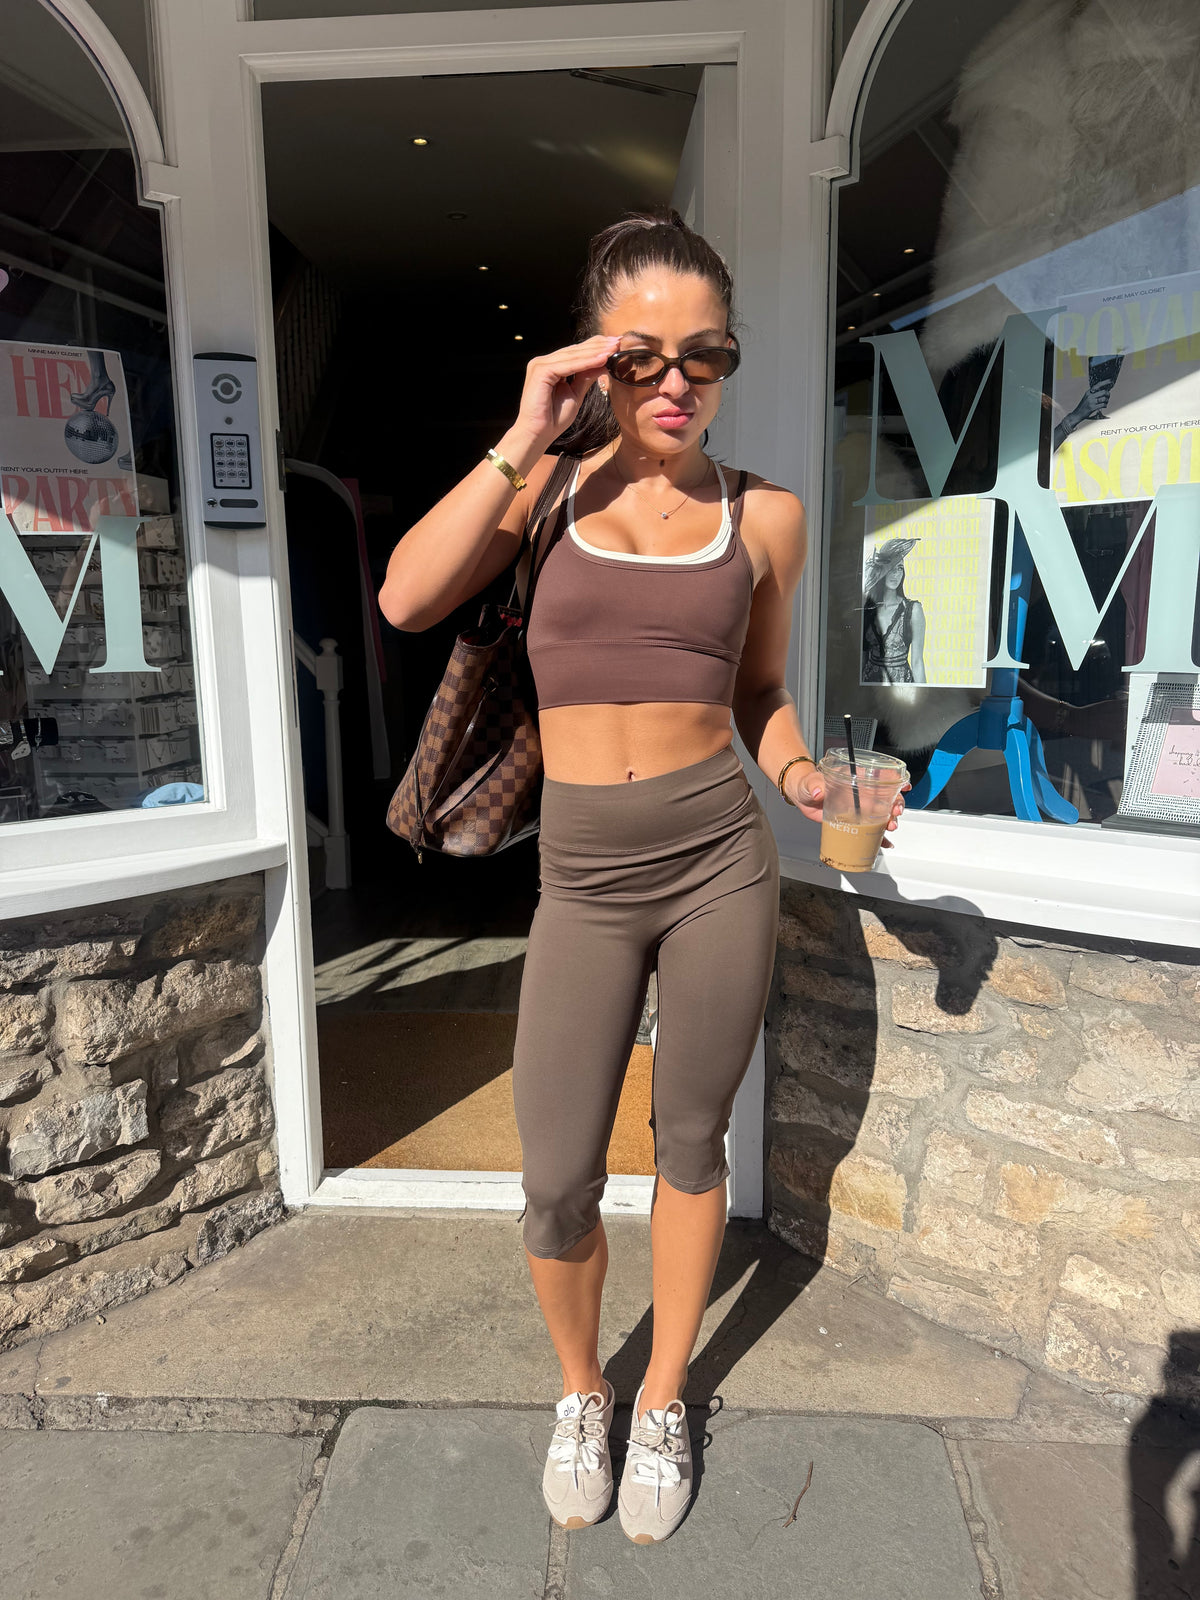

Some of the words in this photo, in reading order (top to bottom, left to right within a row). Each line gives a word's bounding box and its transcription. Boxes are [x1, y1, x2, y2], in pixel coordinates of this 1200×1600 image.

[1139, 286, 1166, 296] CLOSET
[1100, 428, 1123, 436] RENT
[1123, 425, 1147, 433] YOUR
[1148, 421, 1179, 430] OUTFIT
[908, 500, 937, 519] YOUR
[905, 521, 937, 539] YOUR
[940, 518, 981, 537] OUTFIT
[939, 537, 980, 556] OUTFIT
[904, 559, 936, 577] YOUR
[939, 556, 980, 575] OUTFIT
[903, 578, 935, 596] YOUR
[938, 575, 979, 594] OUTFIT
[936, 594, 978, 612] OUTFIT
[935, 613, 977, 631] OUTFIT
[934, 633, 976, 650] OUTFIT
[933, 651, 976, 668] OUTFIT
[563, 1404, 576, 1417] alo
